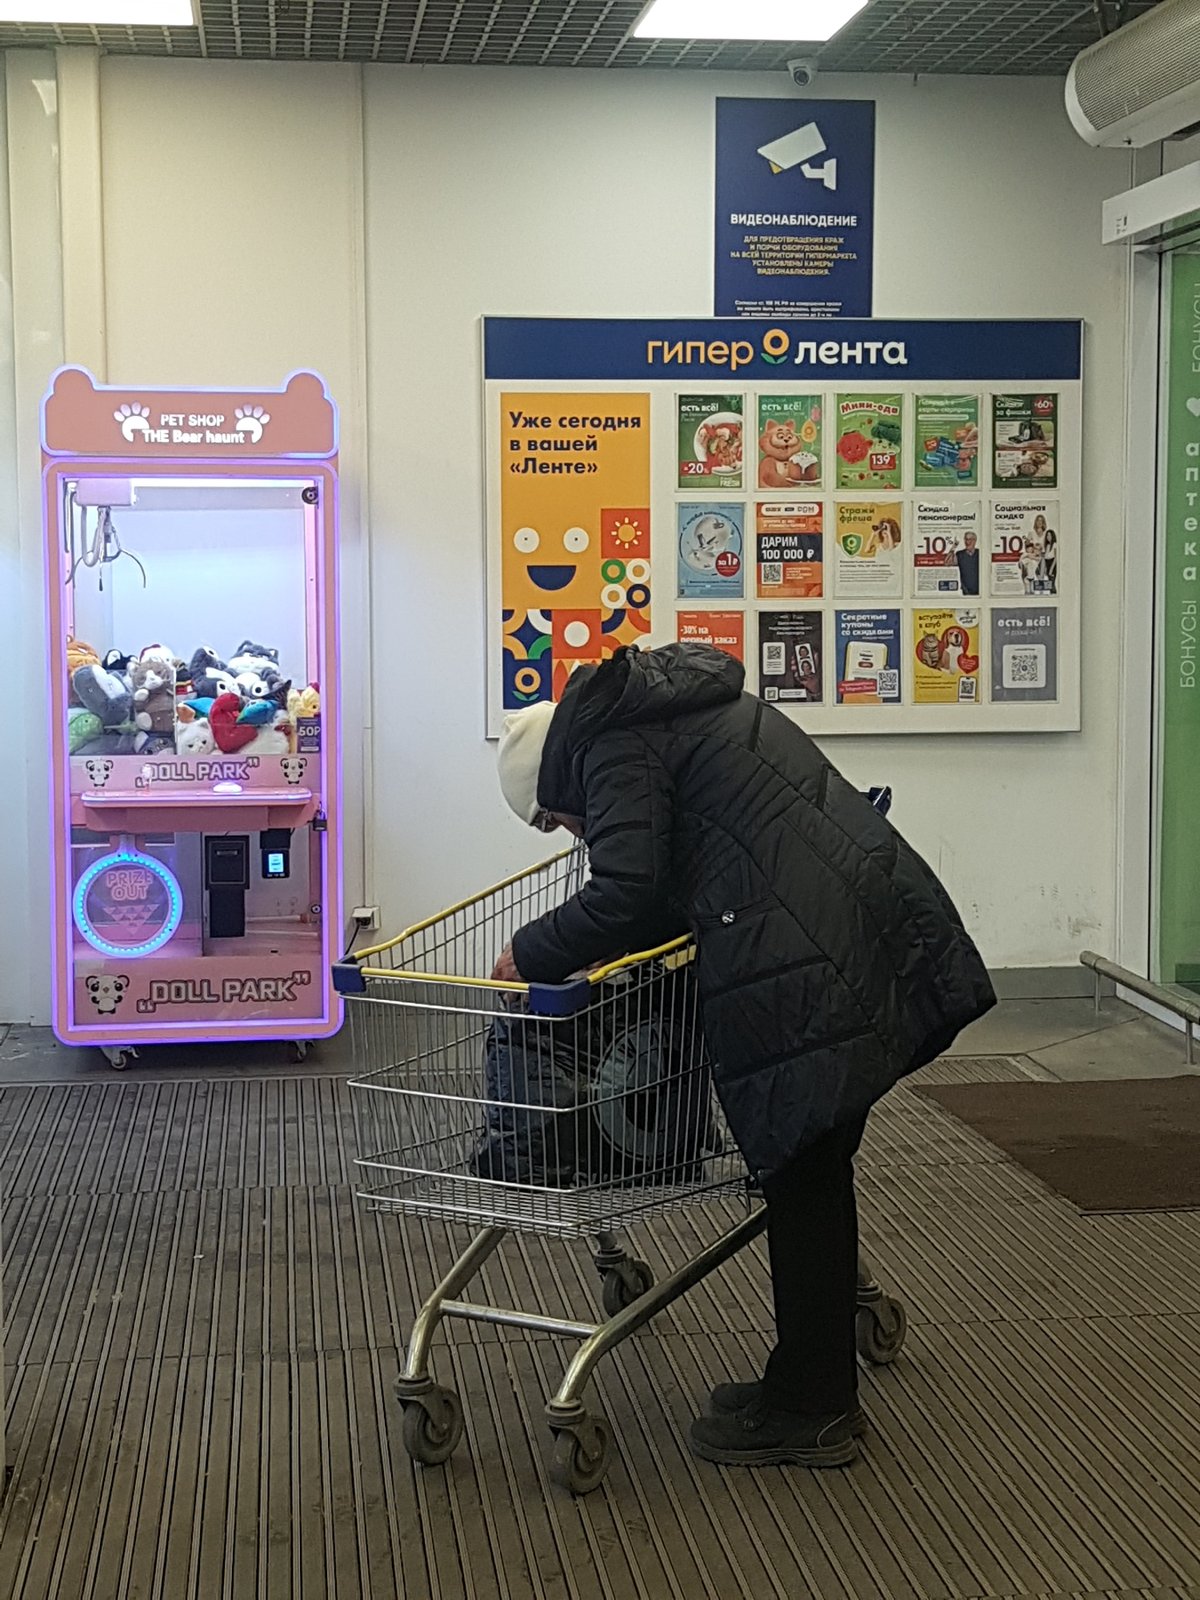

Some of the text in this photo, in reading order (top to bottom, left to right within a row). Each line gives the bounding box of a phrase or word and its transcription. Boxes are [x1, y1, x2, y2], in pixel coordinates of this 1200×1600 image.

[730, 213, 858, 228] ВИДЕОНАБЛЮДЕНИЕ
[743, 235, 844, 244] ДЛЯ ПРЕДОТВРАЩЕНИЯ КРАЖ
[756, 244, 780, 252] ПОРЧИ
[781, 244, 838, 252] ОБОРУДОВАНИЯ
[741, 250, 759, 258] ВСЕЙ
[760, 251, 804, 259] ТЕРРИТОРИИ
[805, 252, 857, 260] ГИПЕРМАРКЕТА
[752, 259, 834, 268] УСТАНОВЛЕНЫ КАМЕРЫ
[647, 341, 908, 371] гипер лента
[761, 403, 782, 411] есть
[160, 413, 225, 427] PET SHOP
[509, 411, 641, 431] Уже сегодня
[142, 429, 245, 443] THE Bear haunt
[510, 434, 598, 451] в вашей
[510, 457, 598, 474] «Ленте»
[872, 455, 890, 465] 139
[839, 506, 875, 516] Стражи
[994, 504, 1046, 512] Социальная
[1182, 442, 1200, 581] аптека
[839, 515, 872, 523] фреша
[918, 513, 976, 522] пенсионерам!
[761, 536, 798, 549] ДАРИМ
[762, 549, 780, 559] 100
[783, 549, 804, 559] 000
[841, 613, 888, 621] Секретные
[997, 615, 1051, 627] есть всё!
[1180, 600, 1197, 688] БОНУСЫ
[106, 869, 153, 888] PRIZE
[111, 884, 147, 900] OUT
